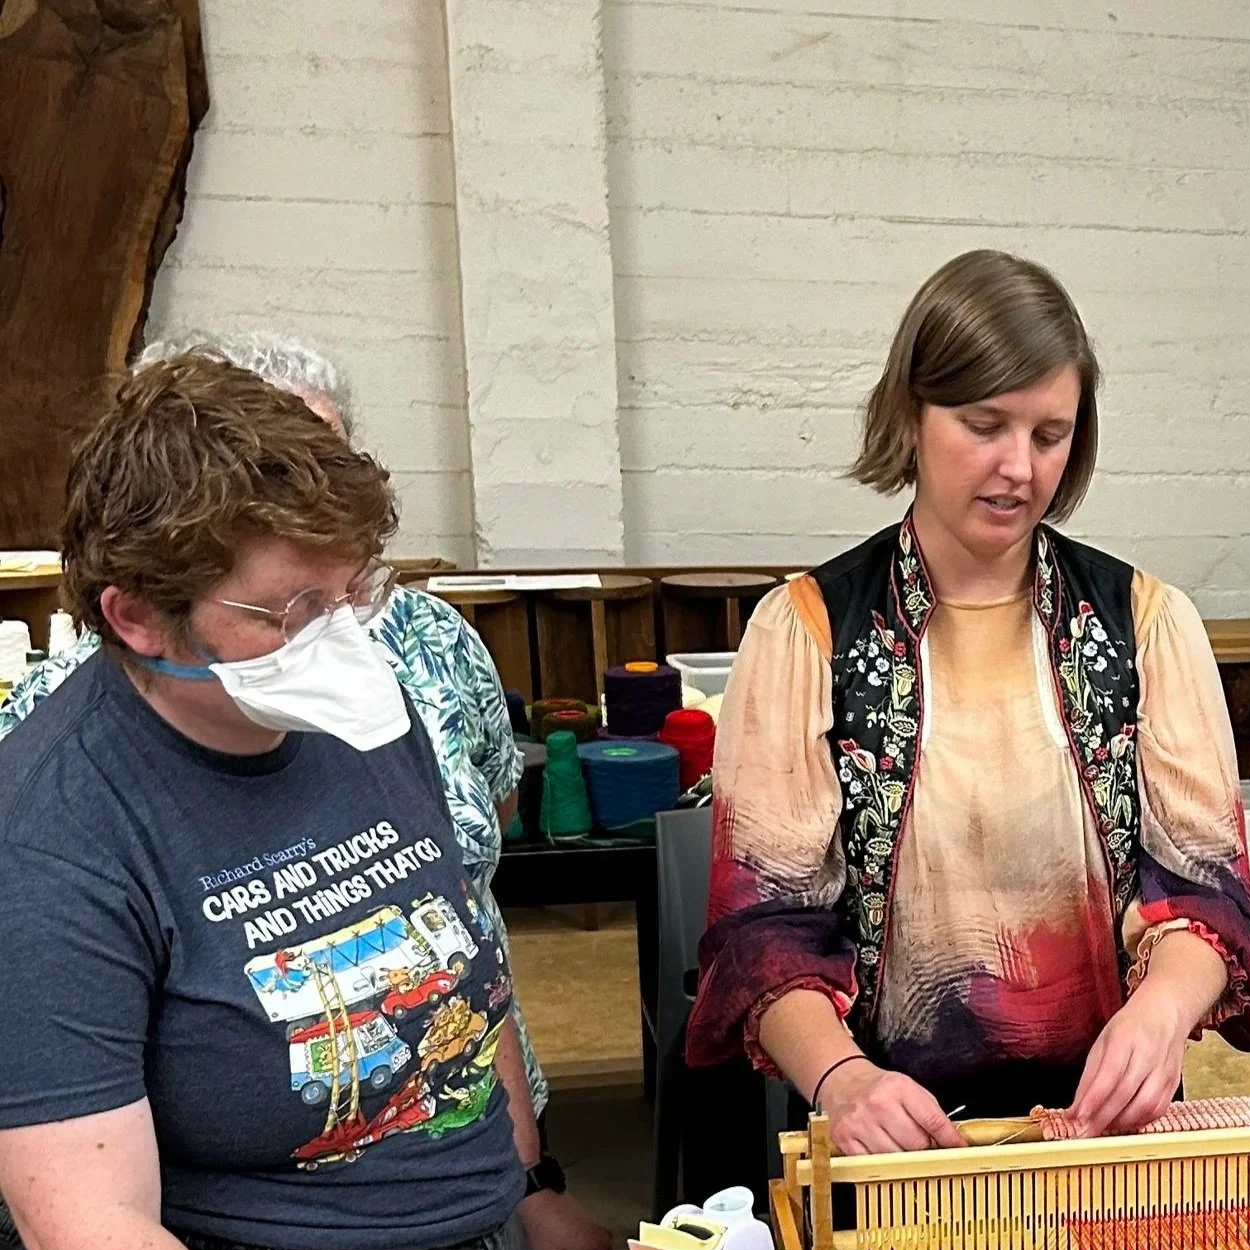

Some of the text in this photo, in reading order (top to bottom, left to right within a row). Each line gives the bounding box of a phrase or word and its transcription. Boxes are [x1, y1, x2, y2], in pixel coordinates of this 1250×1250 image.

[199, 837, 317, 892] Richard Scarry's
[203, 821, 399, 922] CARS AND TRUCKS
[244, 907, 298, 949] AND
[363, 846, 421, 889] THAT
[415, 837, 442, 862] GO
